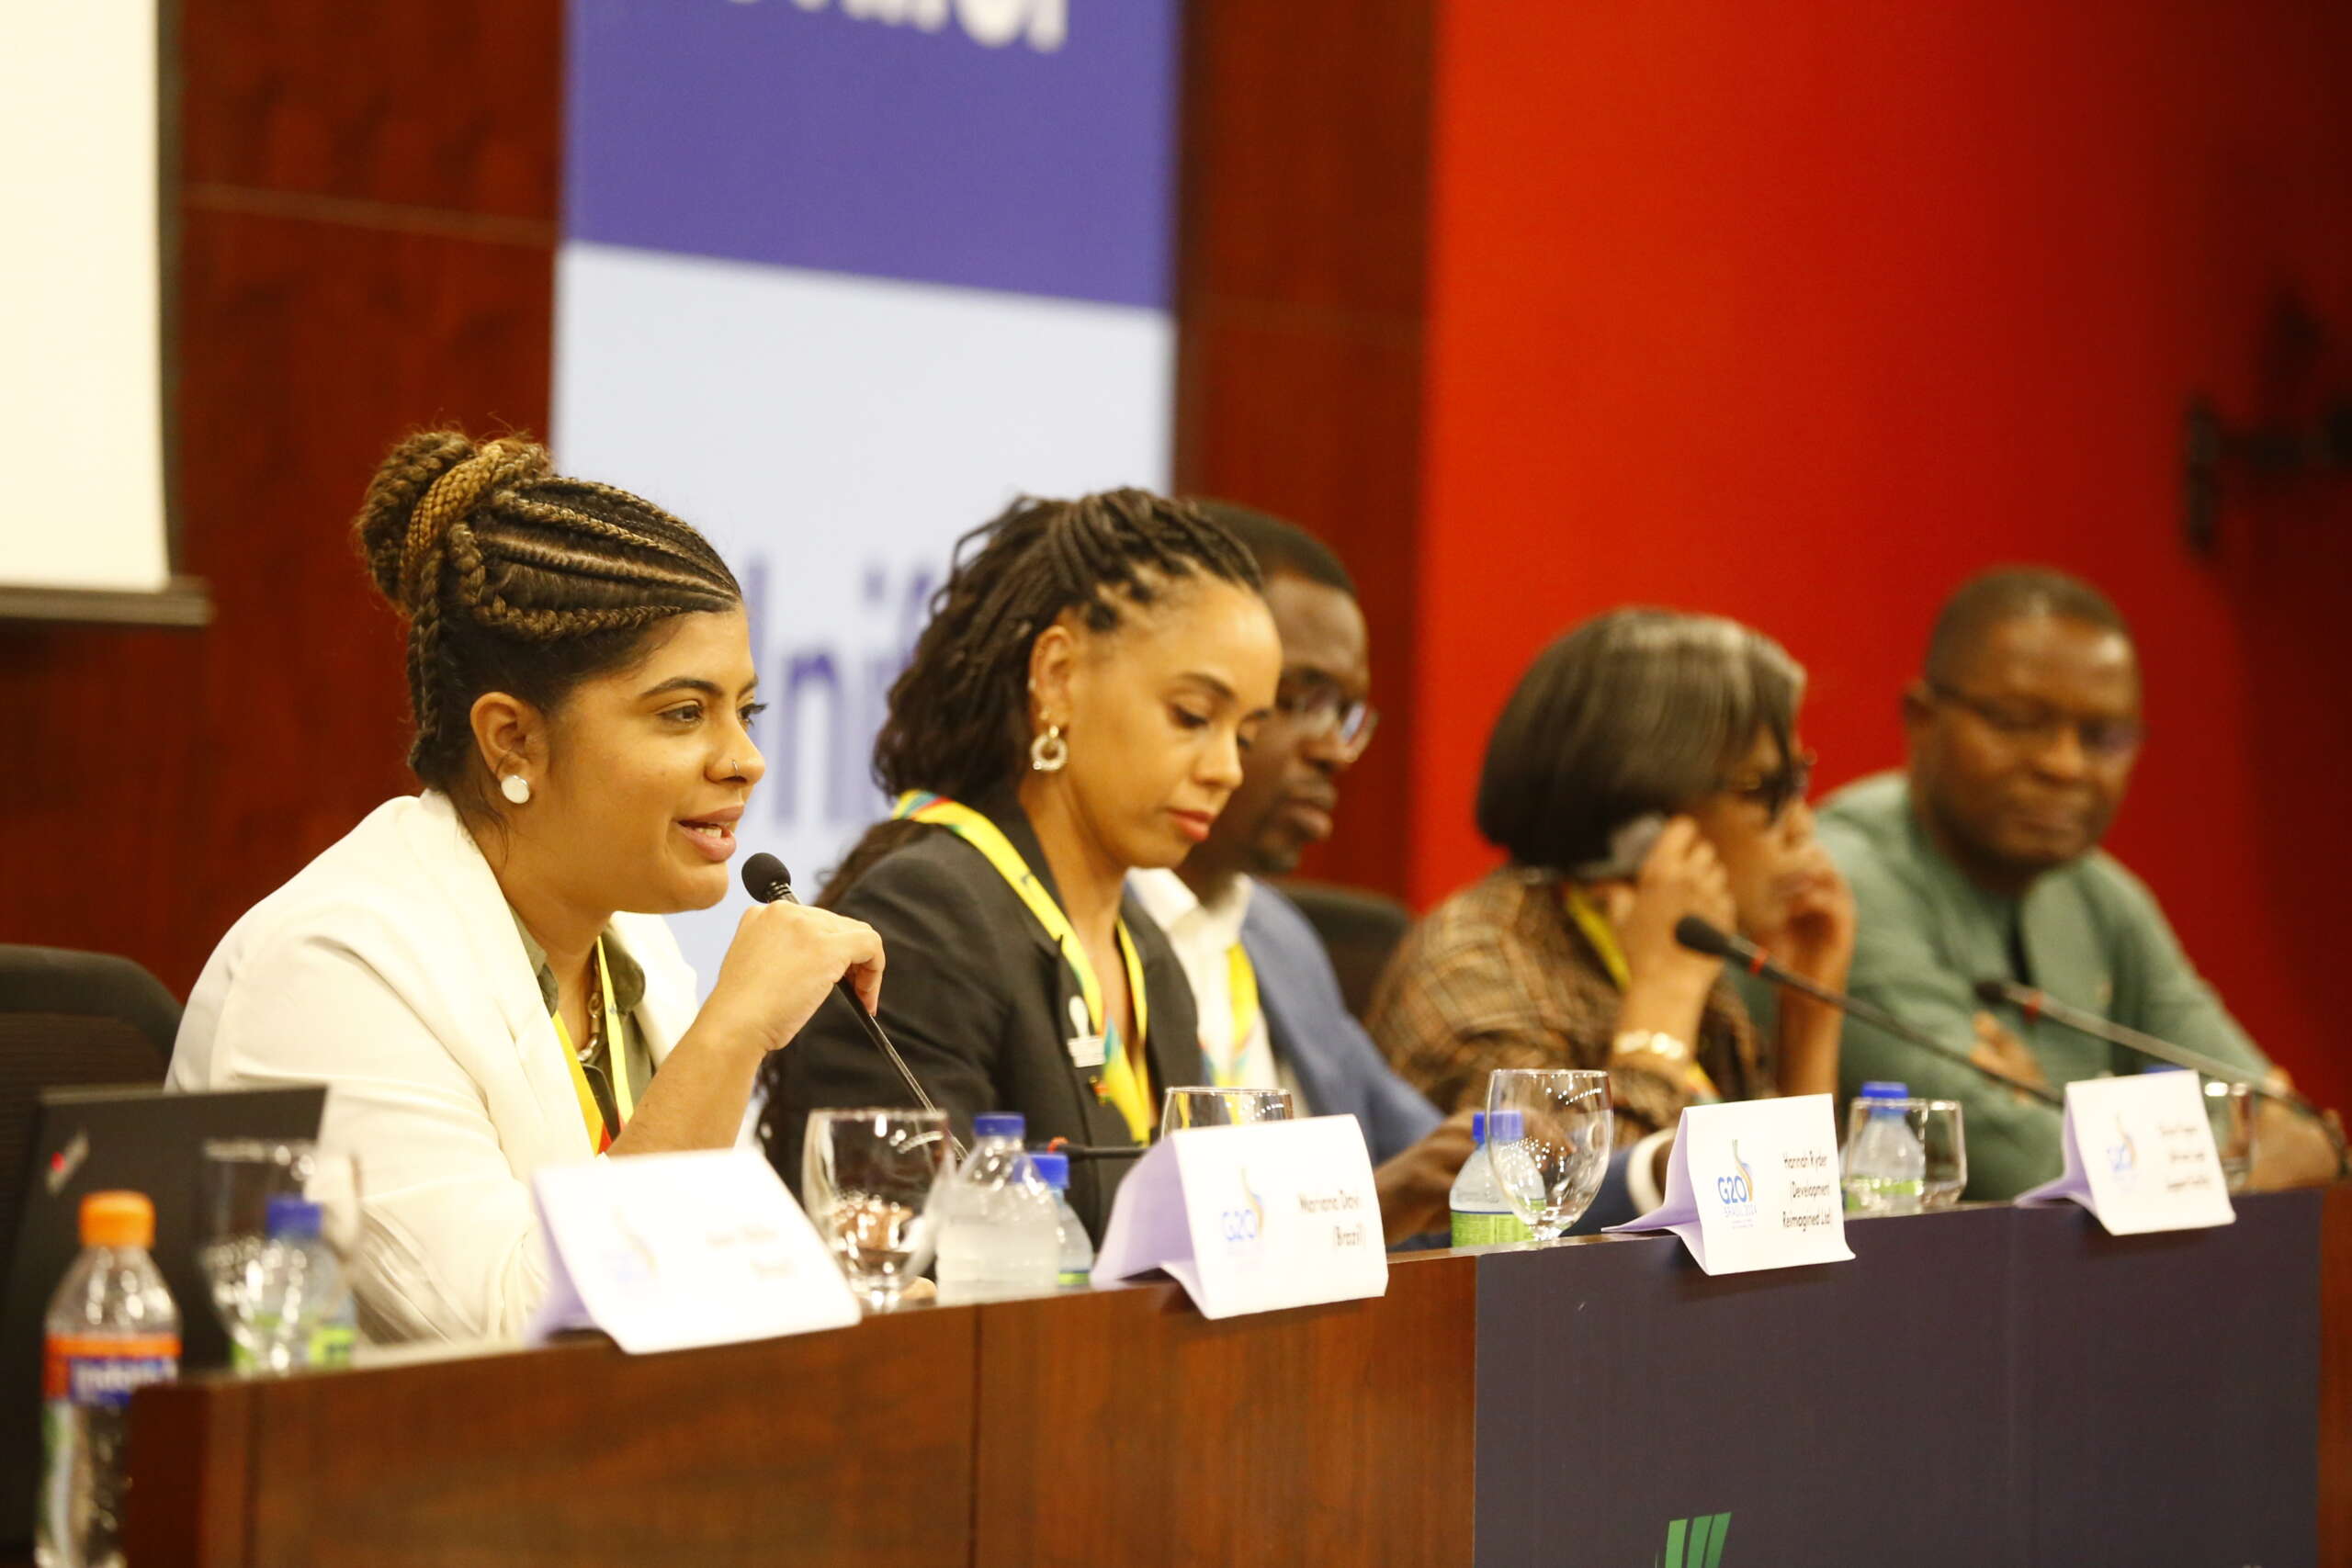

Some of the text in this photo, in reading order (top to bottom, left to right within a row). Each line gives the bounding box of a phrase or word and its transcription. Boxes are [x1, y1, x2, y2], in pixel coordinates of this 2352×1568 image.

[1782, 1148, 1827, 1173] Hannah Ryder
[1717, 1175, 1747, 1204] G20
[1220, 1209, 1259, 1241] G20
[1782, 1208, 1818, 1232] Reimagined
